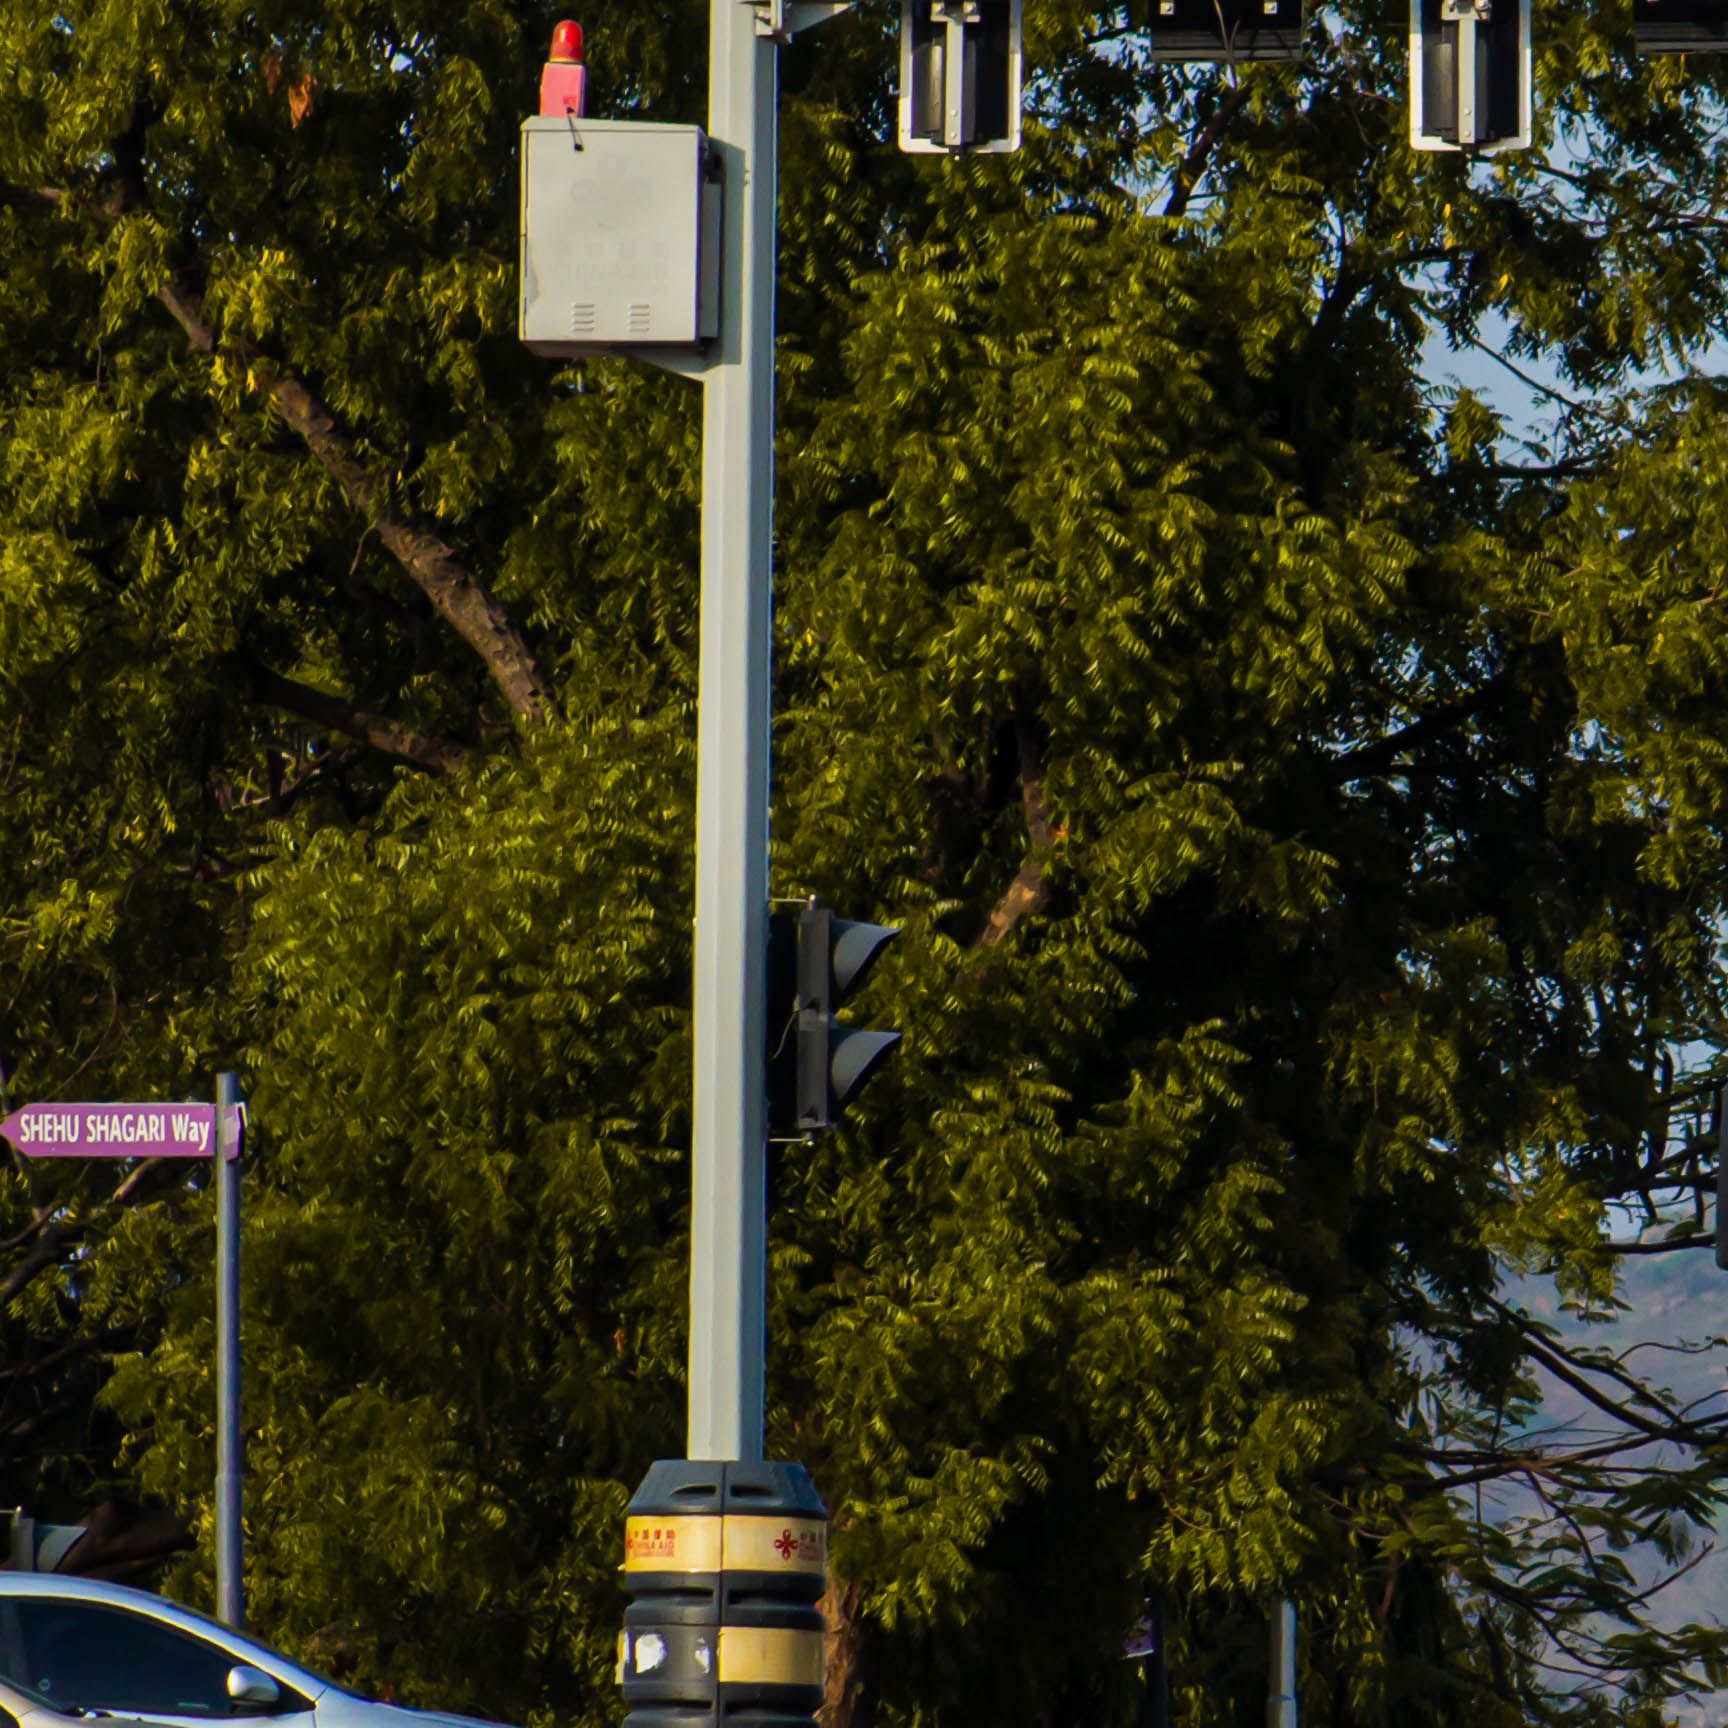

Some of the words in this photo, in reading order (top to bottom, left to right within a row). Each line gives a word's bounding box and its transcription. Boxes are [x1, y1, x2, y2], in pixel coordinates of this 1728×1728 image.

[20, 1113, 79, 1143] SHEHU
[86, 1113, 165, 1143] SHAGARI
[172, 1113, 210, 1151] Way
